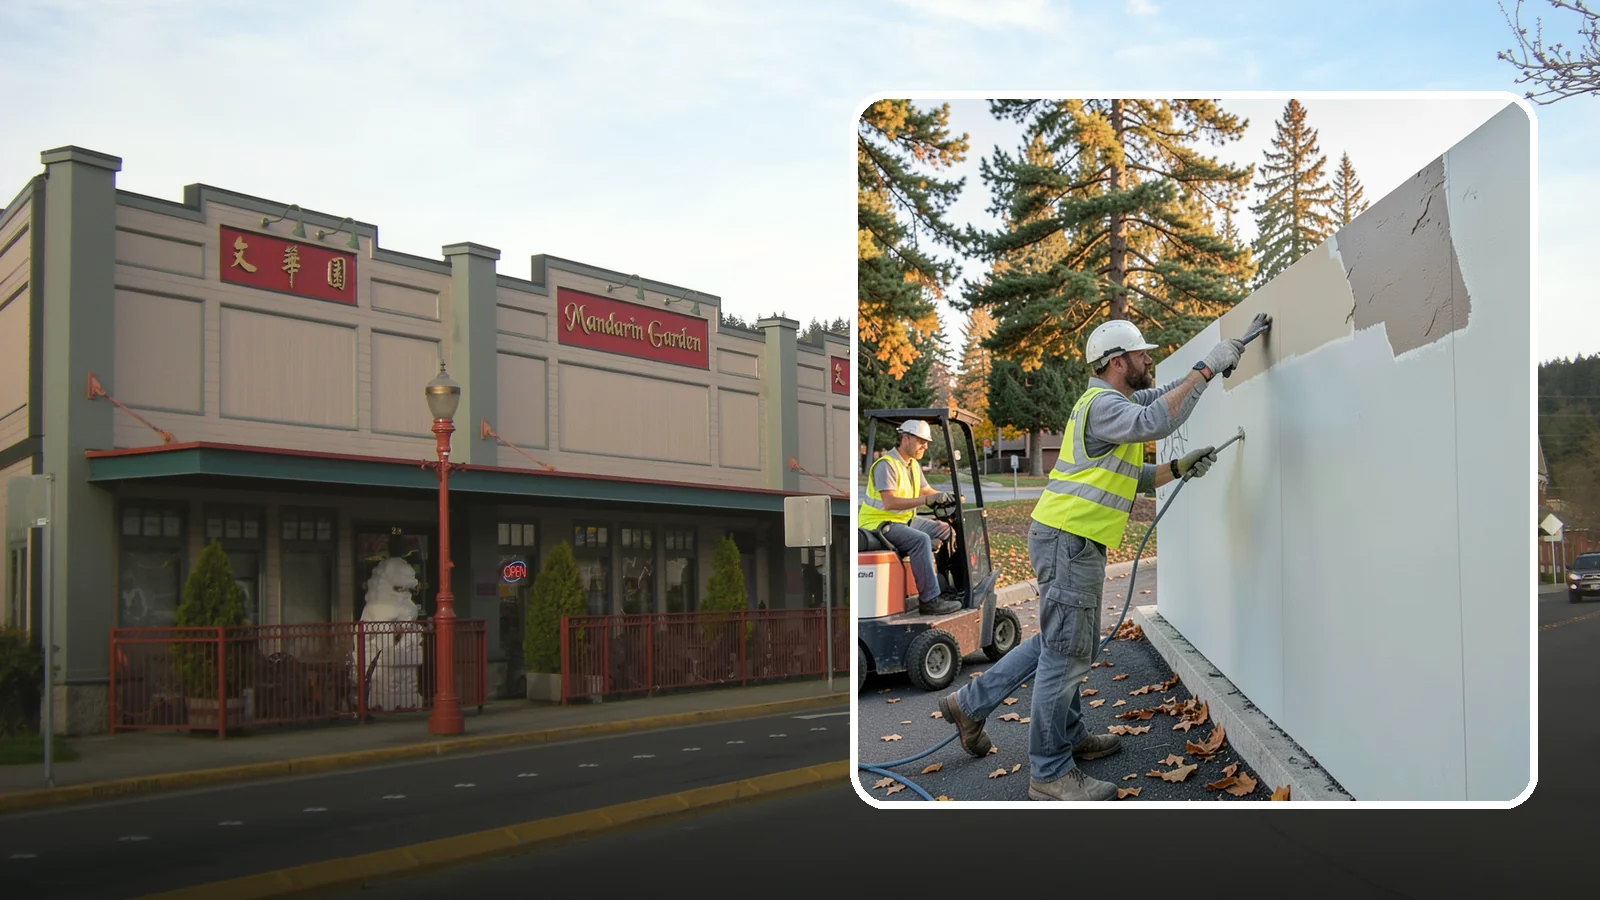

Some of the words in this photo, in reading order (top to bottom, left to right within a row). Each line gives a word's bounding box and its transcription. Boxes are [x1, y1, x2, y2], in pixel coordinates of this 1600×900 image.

[564, 302, 644, 341] Mandarin
[648, 320, 702, 352] Garden
[503, 565, 527, 578] OPEN
